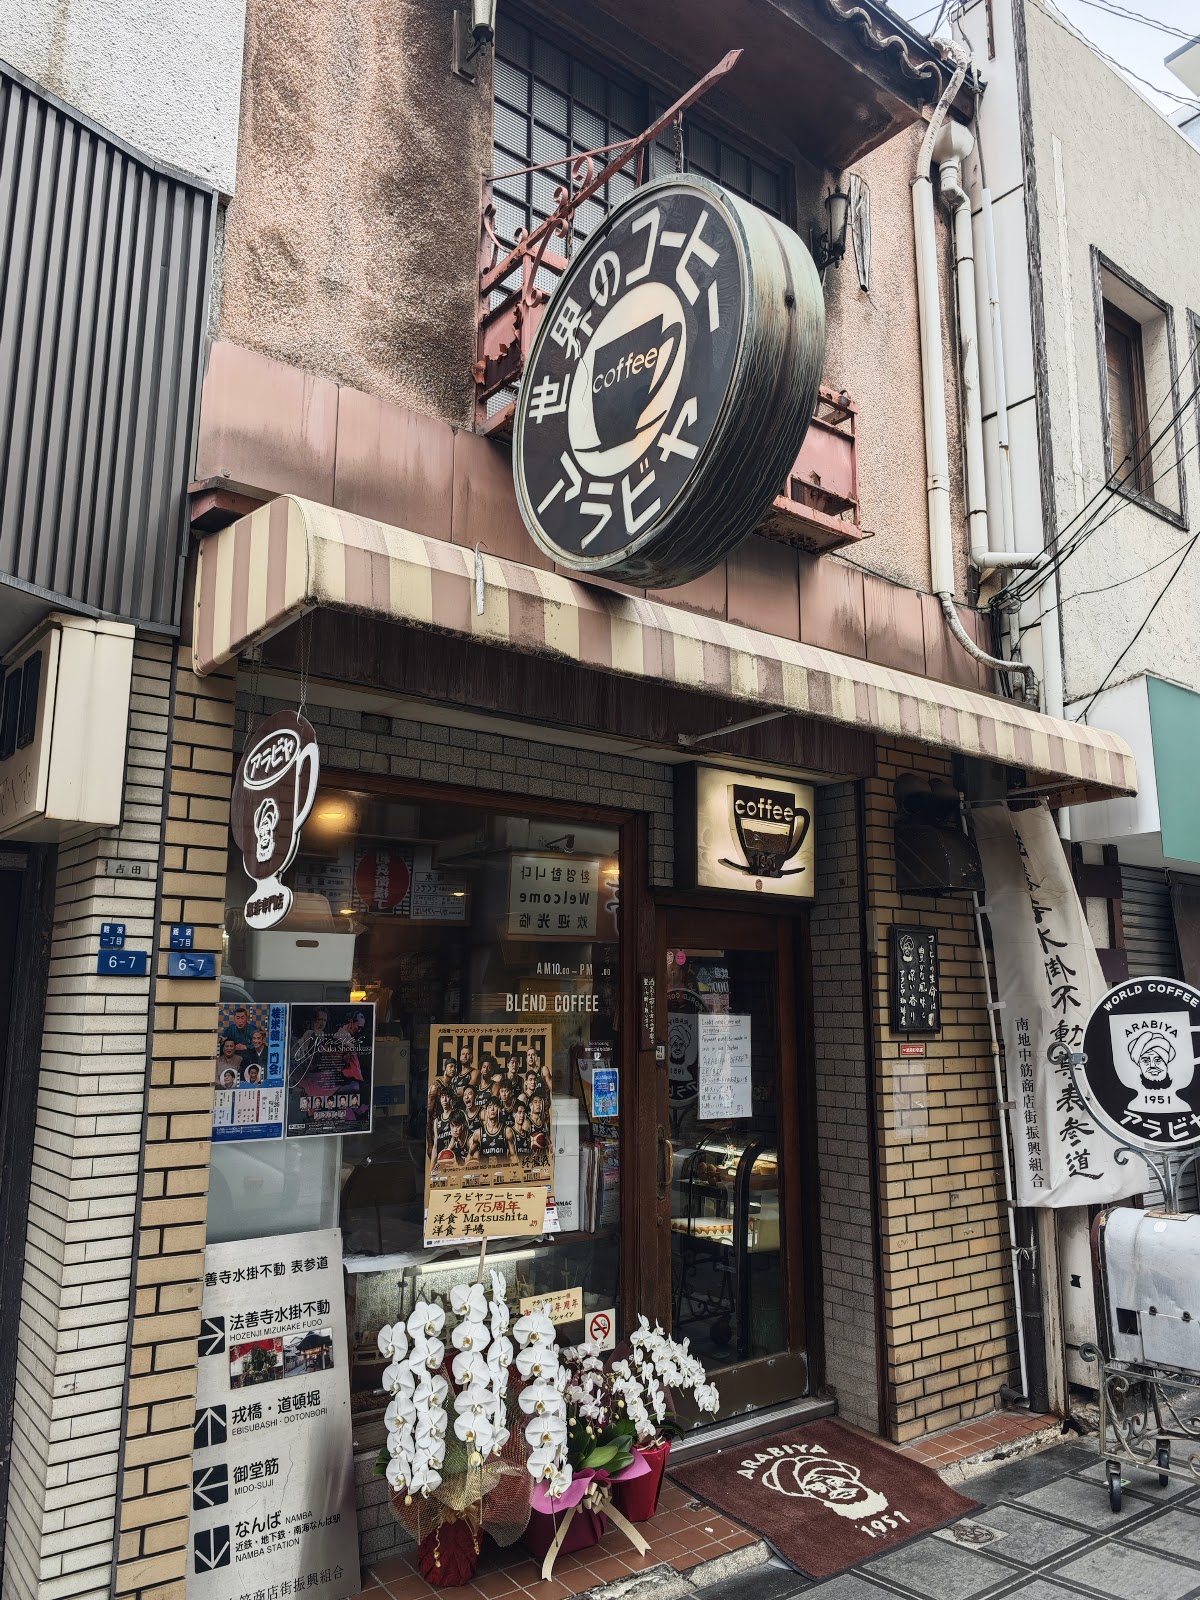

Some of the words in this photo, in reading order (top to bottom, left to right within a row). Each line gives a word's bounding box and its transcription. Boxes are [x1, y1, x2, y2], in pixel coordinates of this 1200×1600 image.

[528, 206, 721, 424] 世界のコーヒー
[592, 346, 660, 394] coffee
[537, 396, 698, 549] アラビヤ
[250, 737, 294, 779] アラビヤ
[735, 797, 794, 822] coffee
[102, 936, 123, 946] 一丁目
[172, 938, 192, 947] 一丁目
[108, 956, 137, 969] 6-7
[178, 959, 205, 971] 6-7
[506, 994, 547, 1012] BLEND
[554, 994, 599, 1012] COFFEE
[1102, 985, 1143, 1012] WORLD
[1147, 983, 1200, 1008] COFFEE
[1125, 1020, 1178, 1038] ARABIYA
[1144, 1095, 1171, 1104] 1951
[443, 1191, 525, 1203] アラビヤコーヒー
[453, 1202, 470, 1214] 祝
[475, 1200, 521, 1213] 75周年
[432, 1224, 457, 1237] 洋食
[433, 1213, 459, 1225] 洋食
[463, 1212, 529, 1223] Matsushita
[290, 1255, 329, 1274] 表参道
[229, 1299, 331, 1331] 法善寺水掛不動
[229, 1330, 262, 1342] HOZENJI
[263, 1323, 301, 1335] MIZUKAKE
[302, 1318, 323, 1329] FUDO
[232, 1389, 321, 1425] 戎橋・道頓堀
[231, 1418, 278, 1437] EBISUBASHI
[284, 1407, 328, 1425] DOTONBORI
[233, 1457, 280, 1484] 御堂筋
[736, 1444, 829, 1480] ARABIYA
[234, 1480, 275, 1496] MIDO-SUJI
[235, 1512, 282, 1538] なんば
[285, 1511, 313, 1524] NAMBA
[861, 1510, 911, 1538] 1951
[235, 1548, 265, 1563] NAMBA
[266, 1537, 300, 1554] STATION
